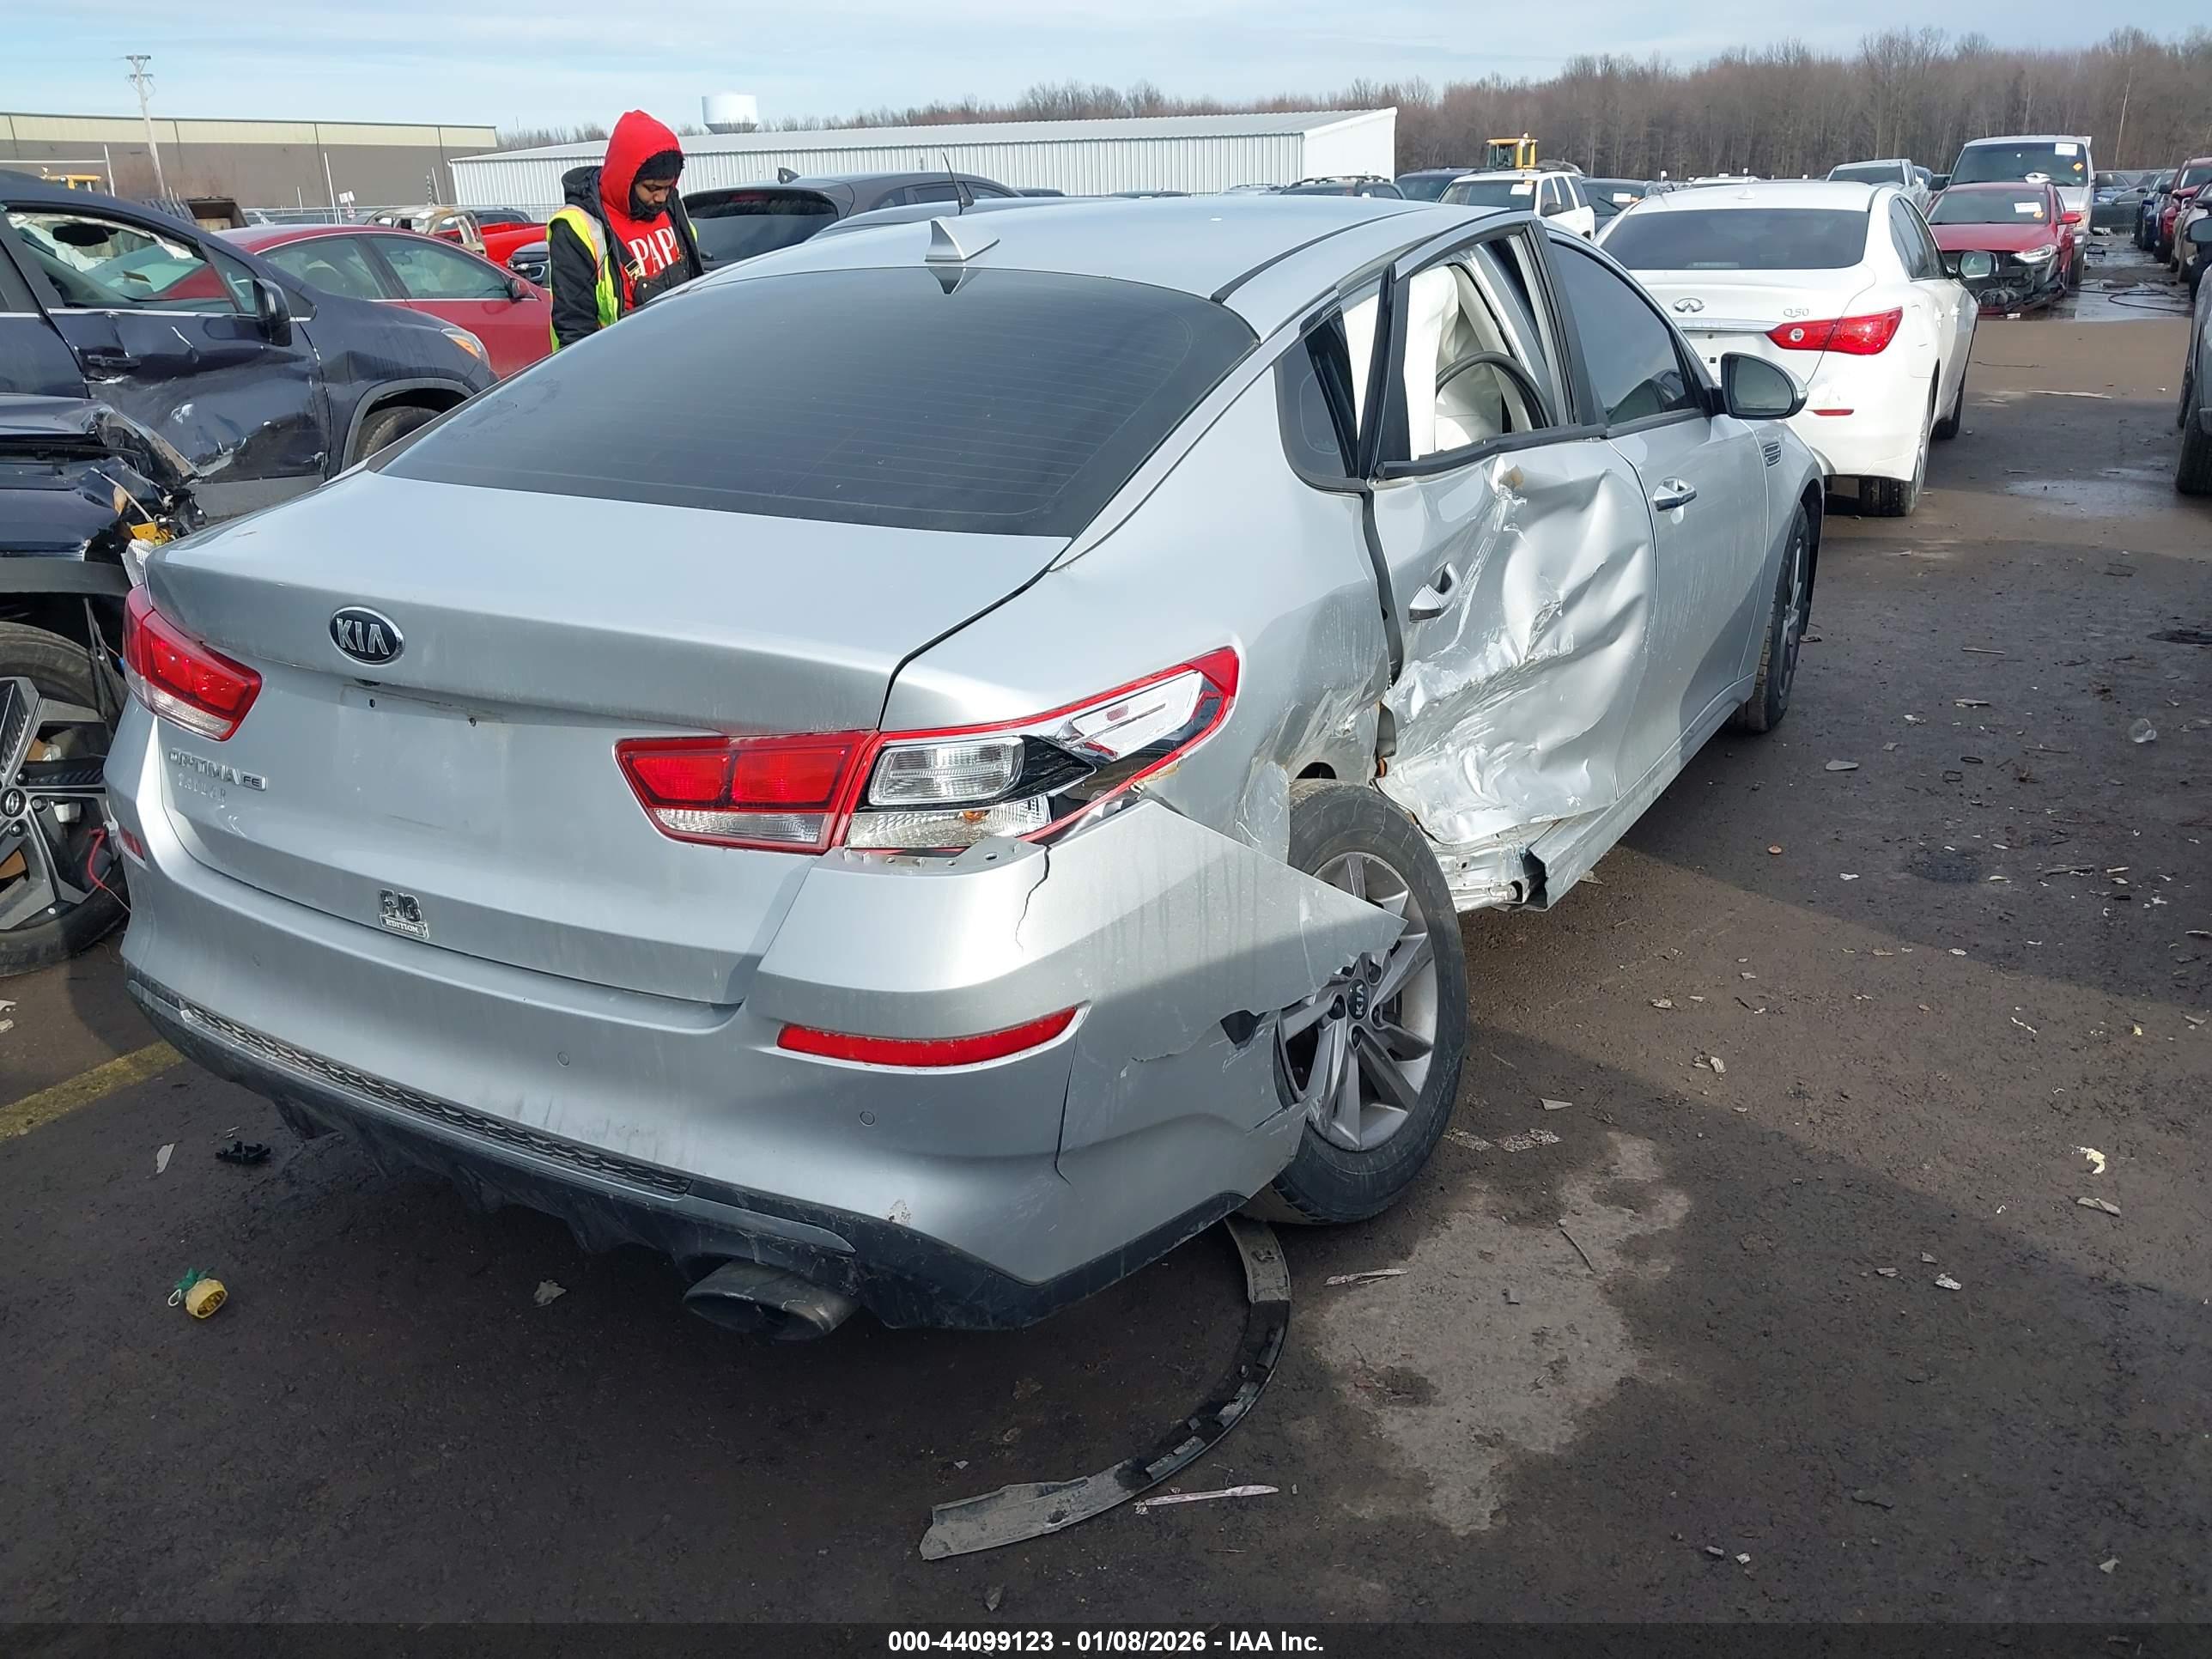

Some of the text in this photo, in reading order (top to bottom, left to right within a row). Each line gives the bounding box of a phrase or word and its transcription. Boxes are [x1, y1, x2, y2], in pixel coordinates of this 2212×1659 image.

[1783, 307, 1810, 319] Q50
[336, 617, 390, 655] KIA
[168, 747, 241, 786] OPTIMA
[385, 918, 419, 933] EDITION
[1355, 983, 1364, 1016] KIA
